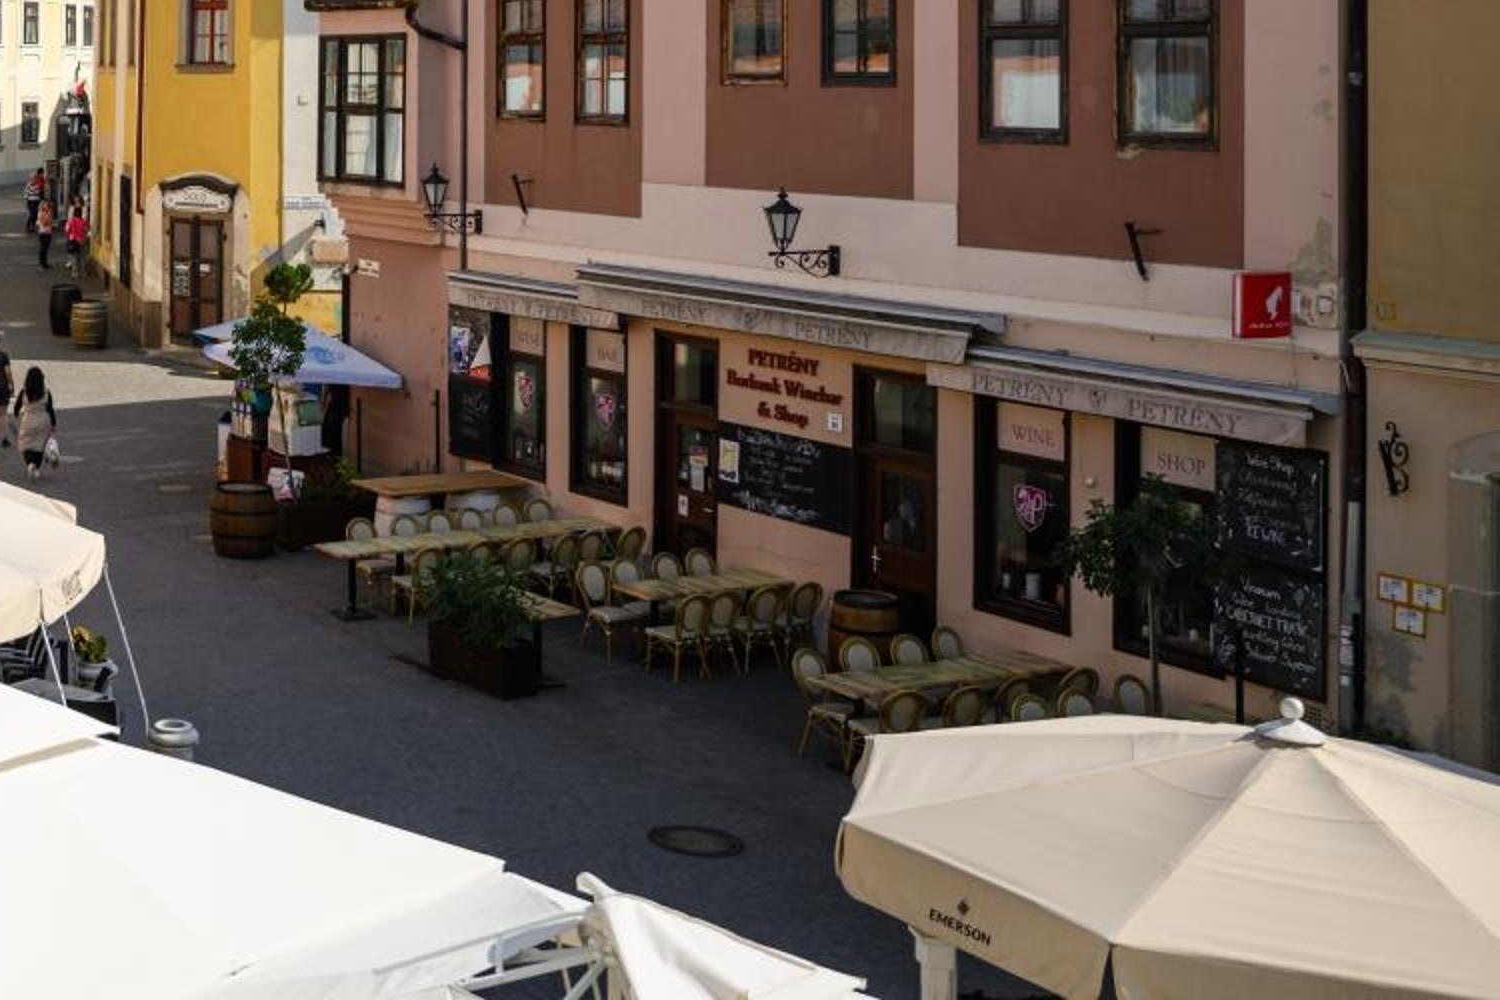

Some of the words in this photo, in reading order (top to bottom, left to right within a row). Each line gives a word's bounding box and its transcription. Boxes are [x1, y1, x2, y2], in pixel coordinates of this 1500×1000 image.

[774, 403, 810, 430] Shop
[1011, 423, 1056, 448] WINE
[1156, 450, 1206, 475] SHOP
[928, 908, 992, 947] EMERSON
